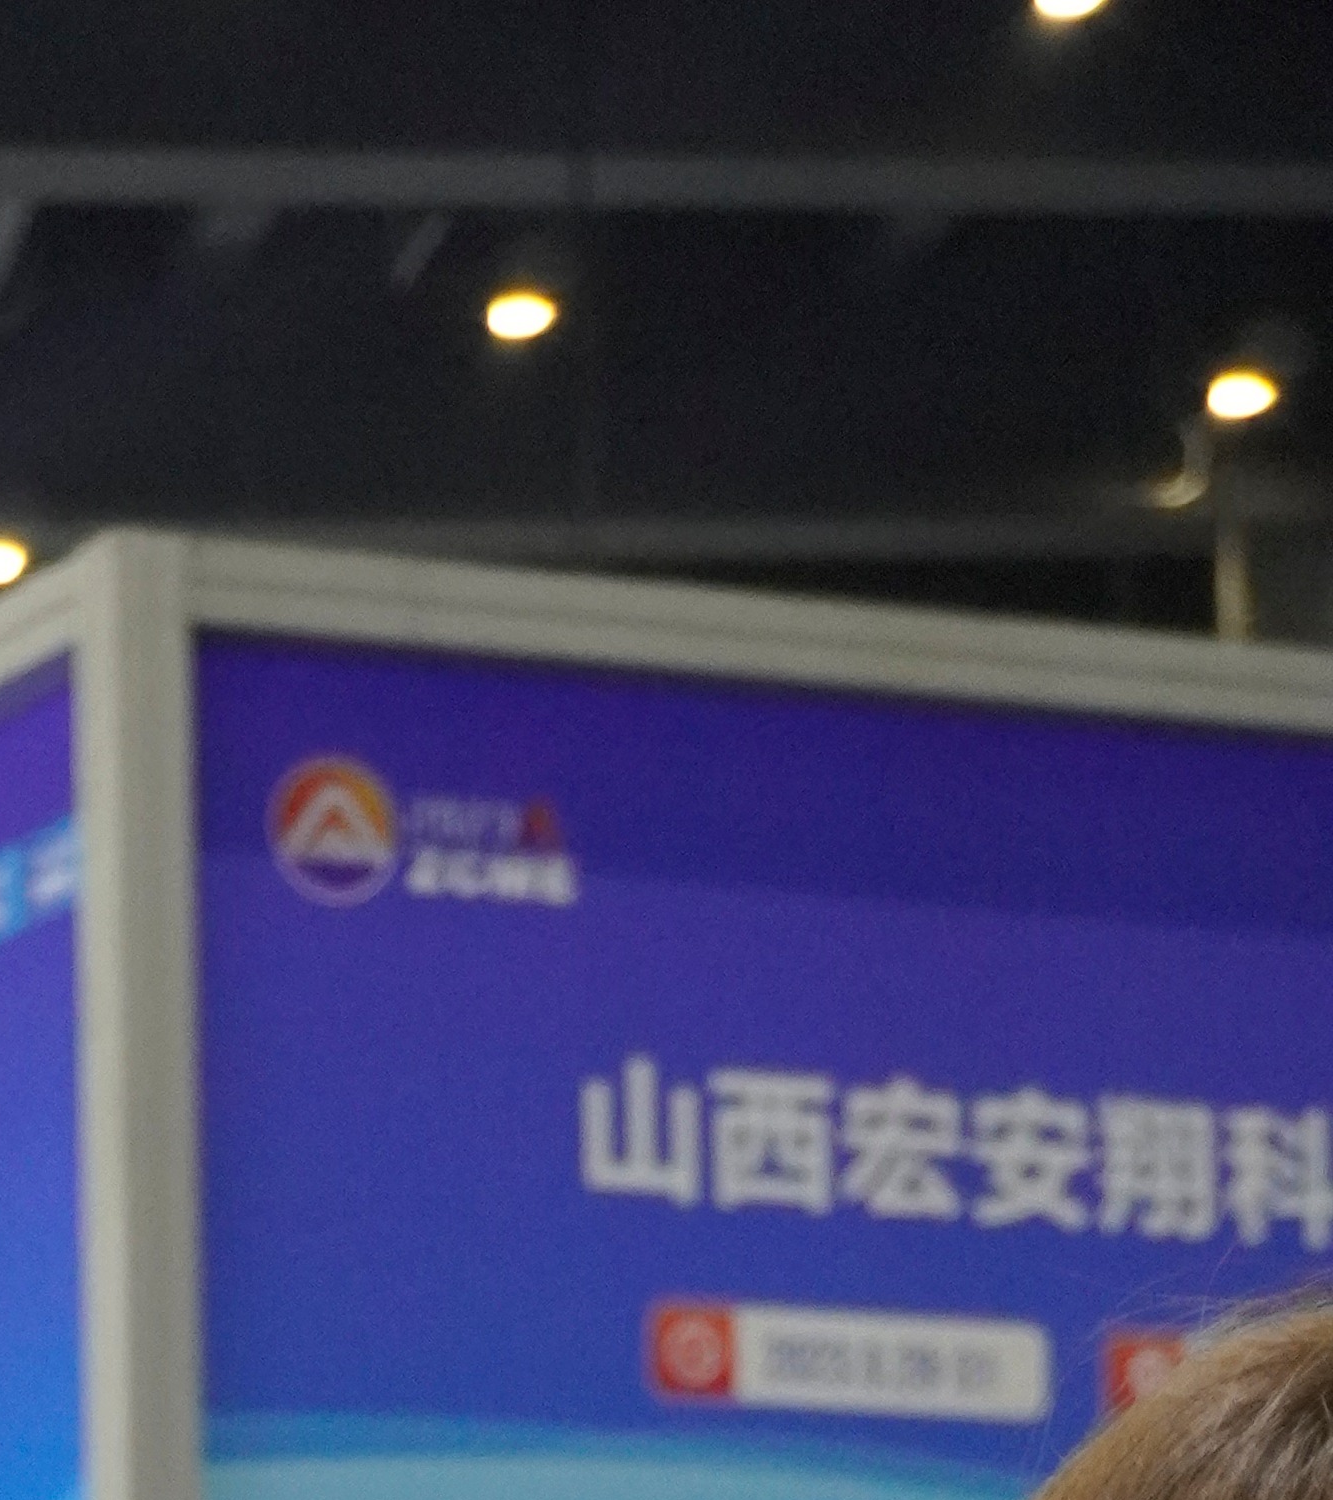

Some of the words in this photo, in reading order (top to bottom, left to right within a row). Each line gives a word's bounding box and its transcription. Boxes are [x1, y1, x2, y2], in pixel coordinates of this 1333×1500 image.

[578, 1052, 1333, 1252] 山西宏安翔科
